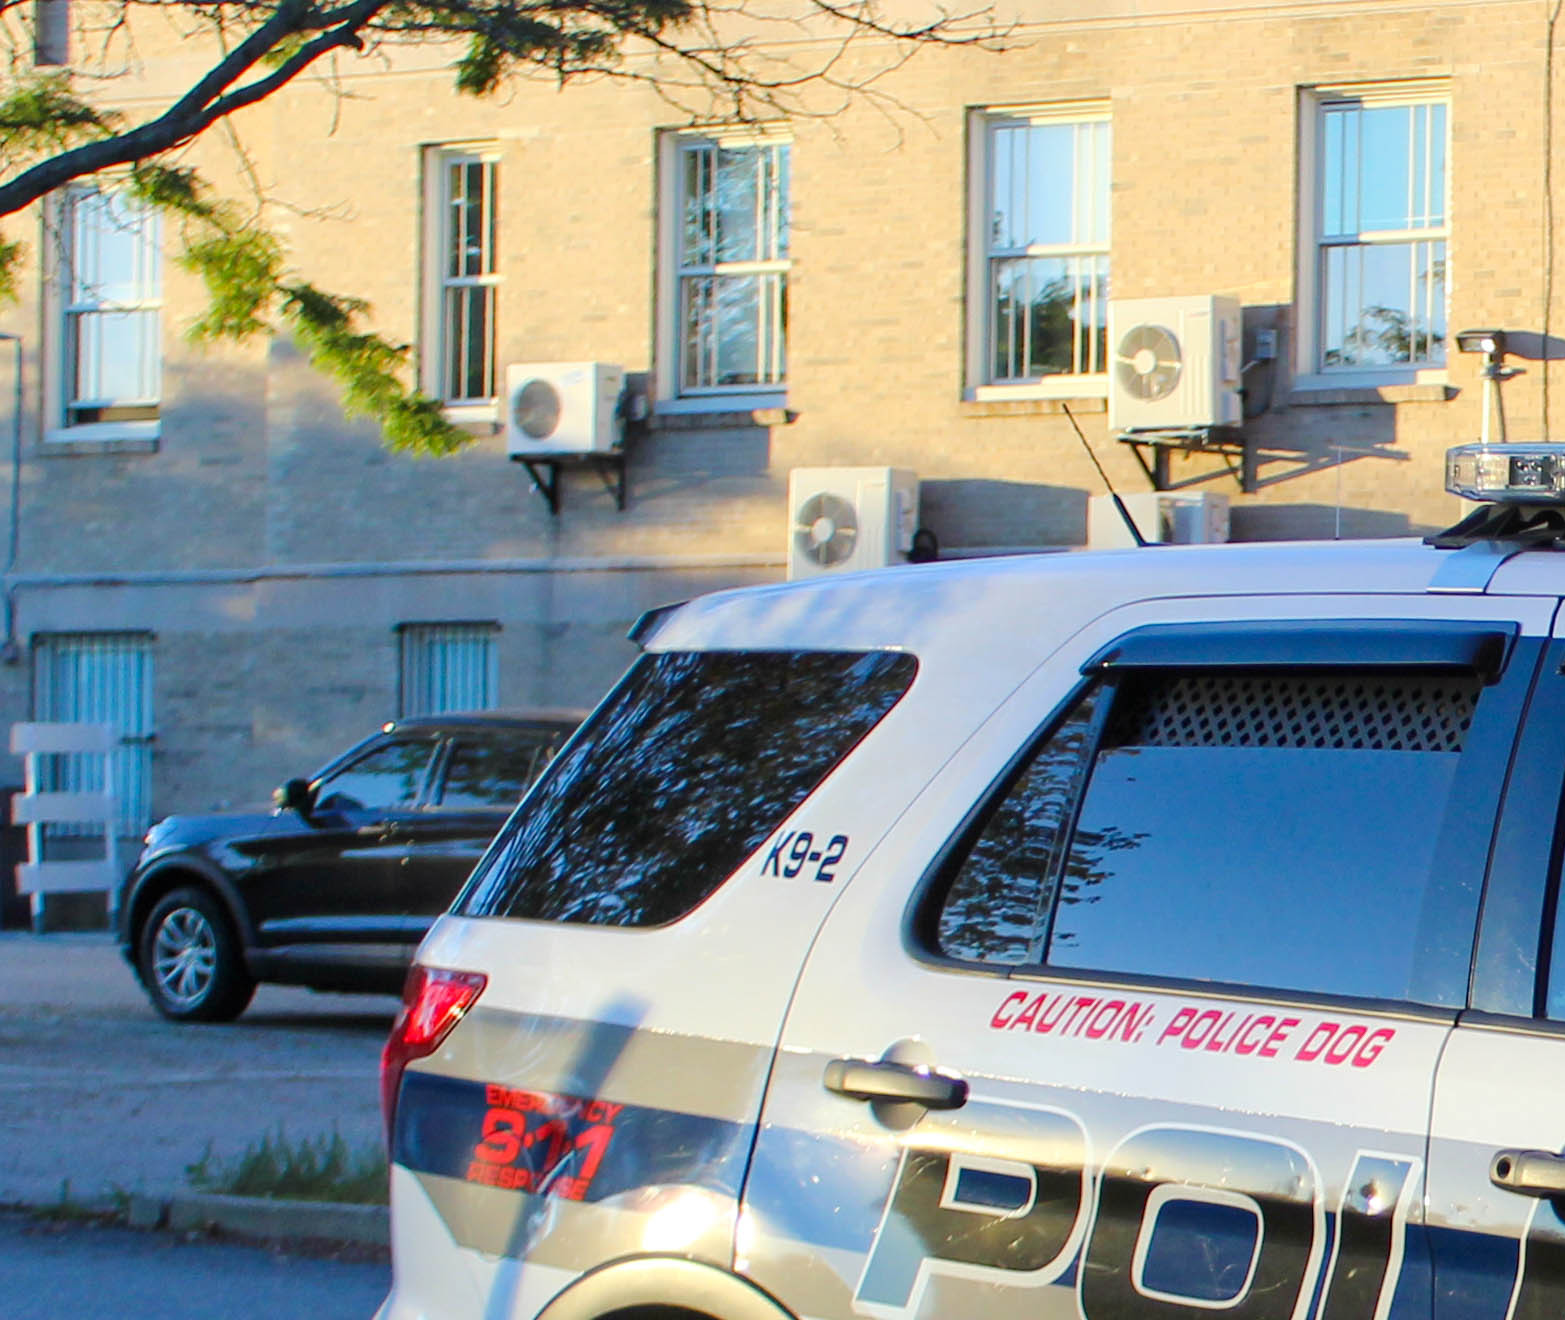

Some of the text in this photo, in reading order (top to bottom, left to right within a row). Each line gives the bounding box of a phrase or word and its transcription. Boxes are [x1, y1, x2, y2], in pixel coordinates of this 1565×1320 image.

[760, 830, 849, 882] K9-2
[988, 990, 1397, 1069] CAUTION: POLICE DOG
